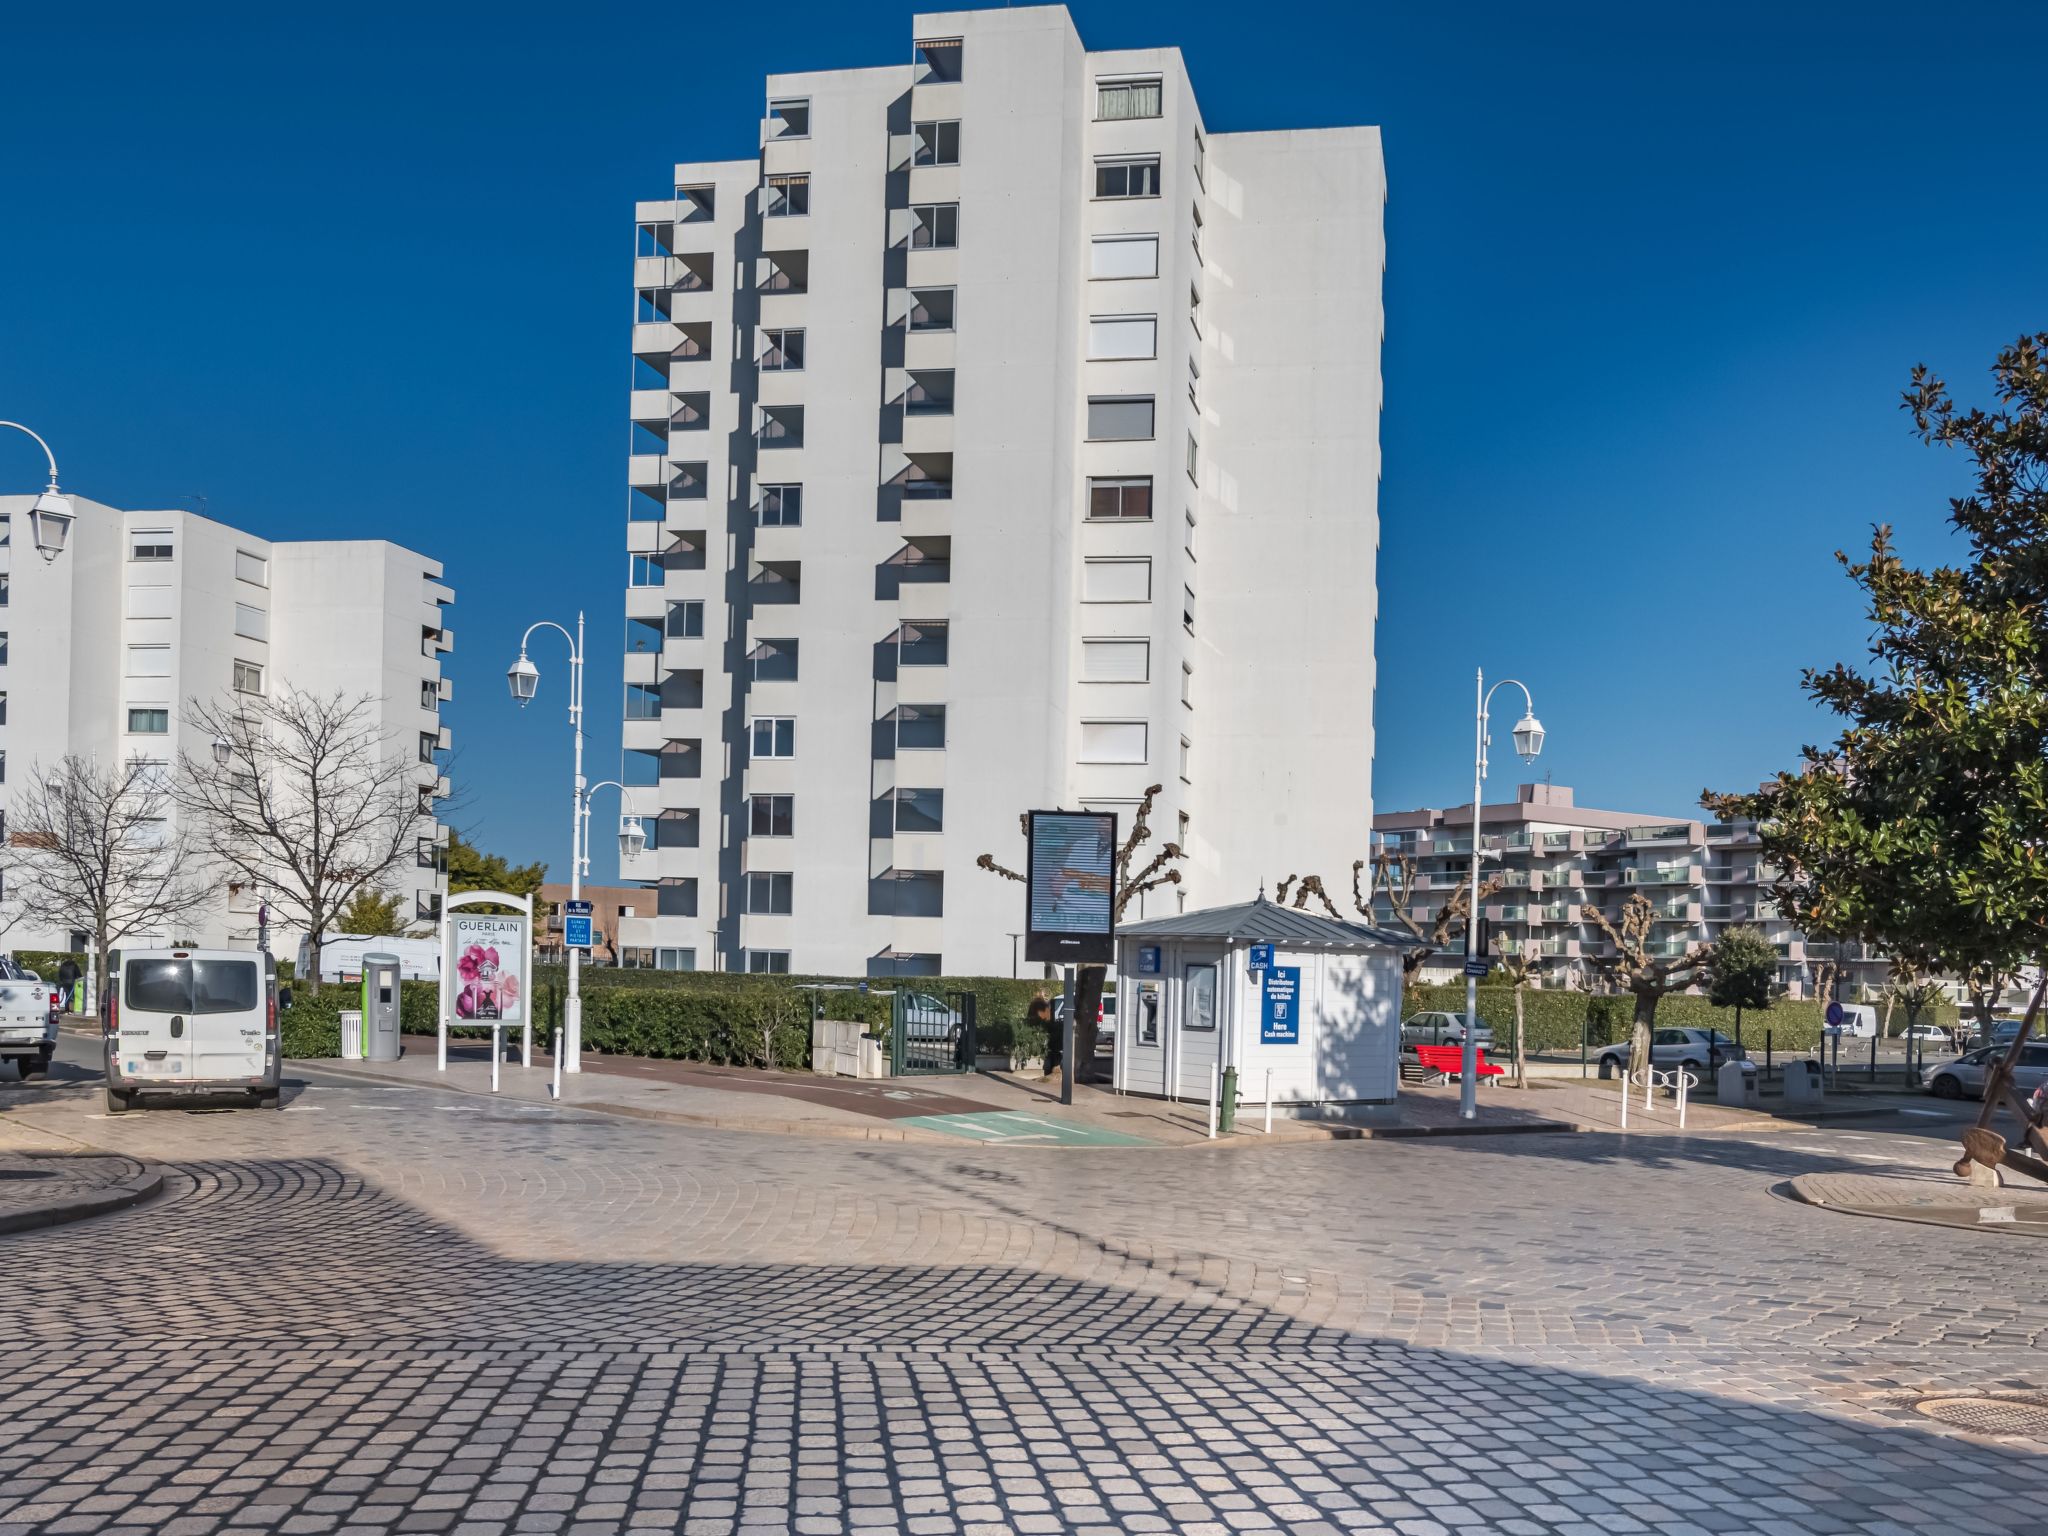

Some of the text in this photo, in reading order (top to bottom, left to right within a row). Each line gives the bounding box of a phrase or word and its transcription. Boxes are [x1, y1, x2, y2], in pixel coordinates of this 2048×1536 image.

[459, 921, 518, 932] GUERLAIN
[1251, 962, 1268, 970] CASH
[1277, 970, 1285, 978] Ici
[1268, 978, 1295, 986] Distributeur
[1273, 1022, 1287, 1031] Here
[1264, 1030, 1296, 1038] Cash machine
